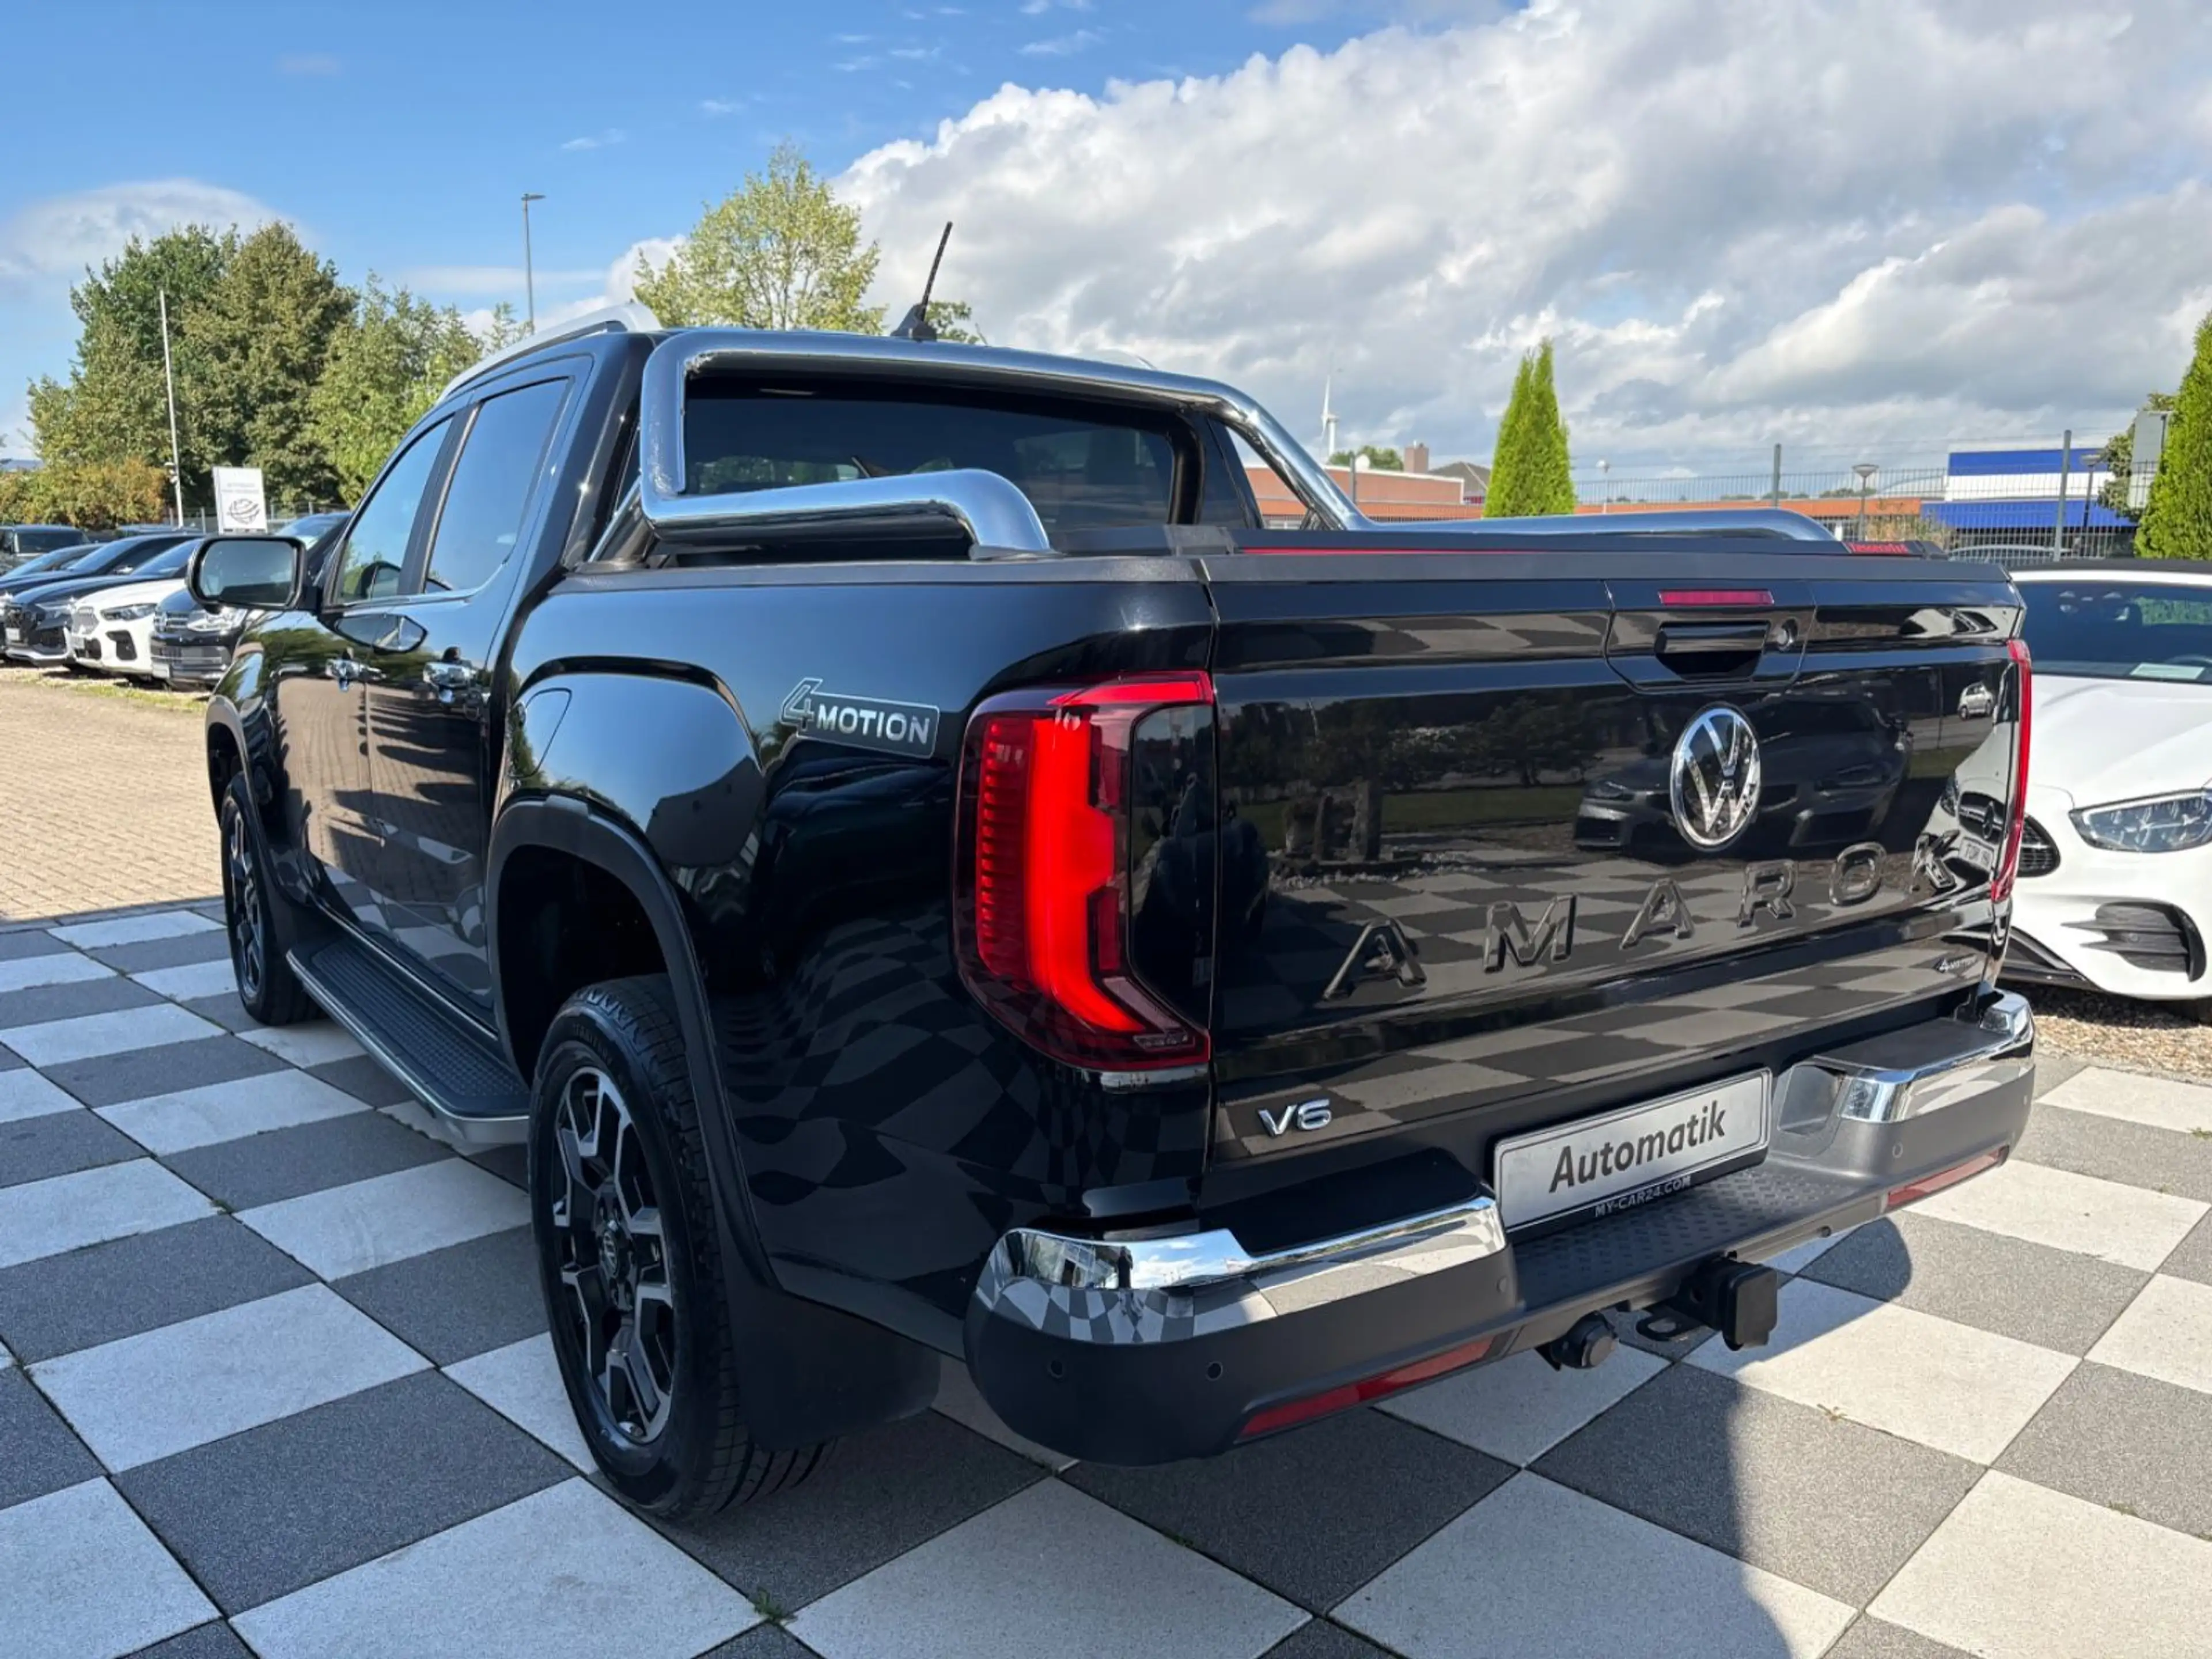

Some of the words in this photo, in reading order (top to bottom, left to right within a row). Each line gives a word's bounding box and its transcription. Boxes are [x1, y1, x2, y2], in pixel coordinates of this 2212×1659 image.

[782, 682, 931, 745] 4MOTION
[1321, 828, 1961, 1000] AMAROK
[1257, 1098, 1332, 1135] V6
[1548, 1100, 1726, 1194] Automatik
[1594, 1174, 1692, 1218] MY-CAR24.COM
